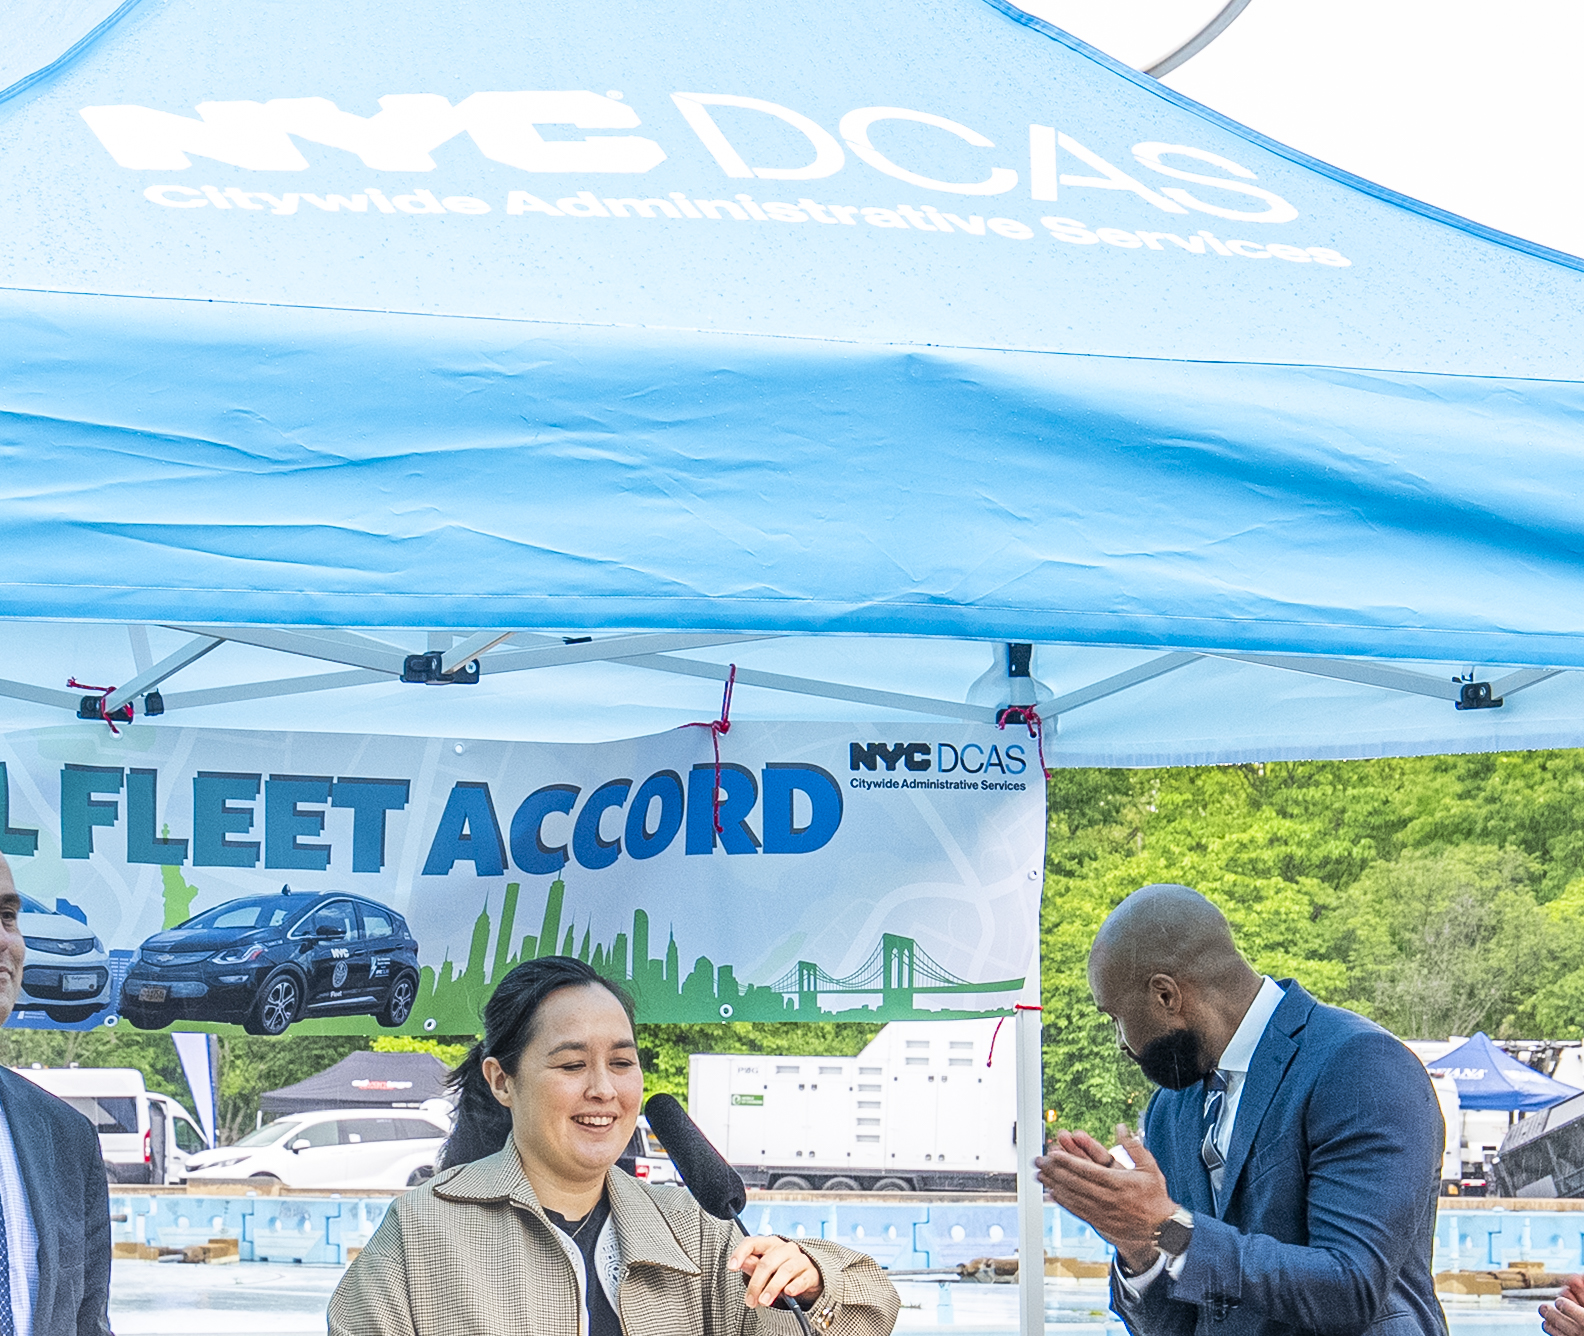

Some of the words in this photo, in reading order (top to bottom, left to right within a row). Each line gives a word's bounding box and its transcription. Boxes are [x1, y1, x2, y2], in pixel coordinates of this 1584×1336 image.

[78, 90, 666, 173] NYC
[670, 91, 1299, 224] DCAS
[143, 181, 485, 216] Citywide
[507, 190, 1033, 241] Administrative
[1039, 213, 1351, 268] Services
[850, 743, 931, 771] NYC
[938, 743, 1026, 774] DCAS
[850, 778, 899, 791] Citywide
[901, 778, 978, 790] Administrative
[980, 780, 1026, 791] Services
[61, 763, 411, 874] FLEET
[421, 761, 843, 876] ACCORD
